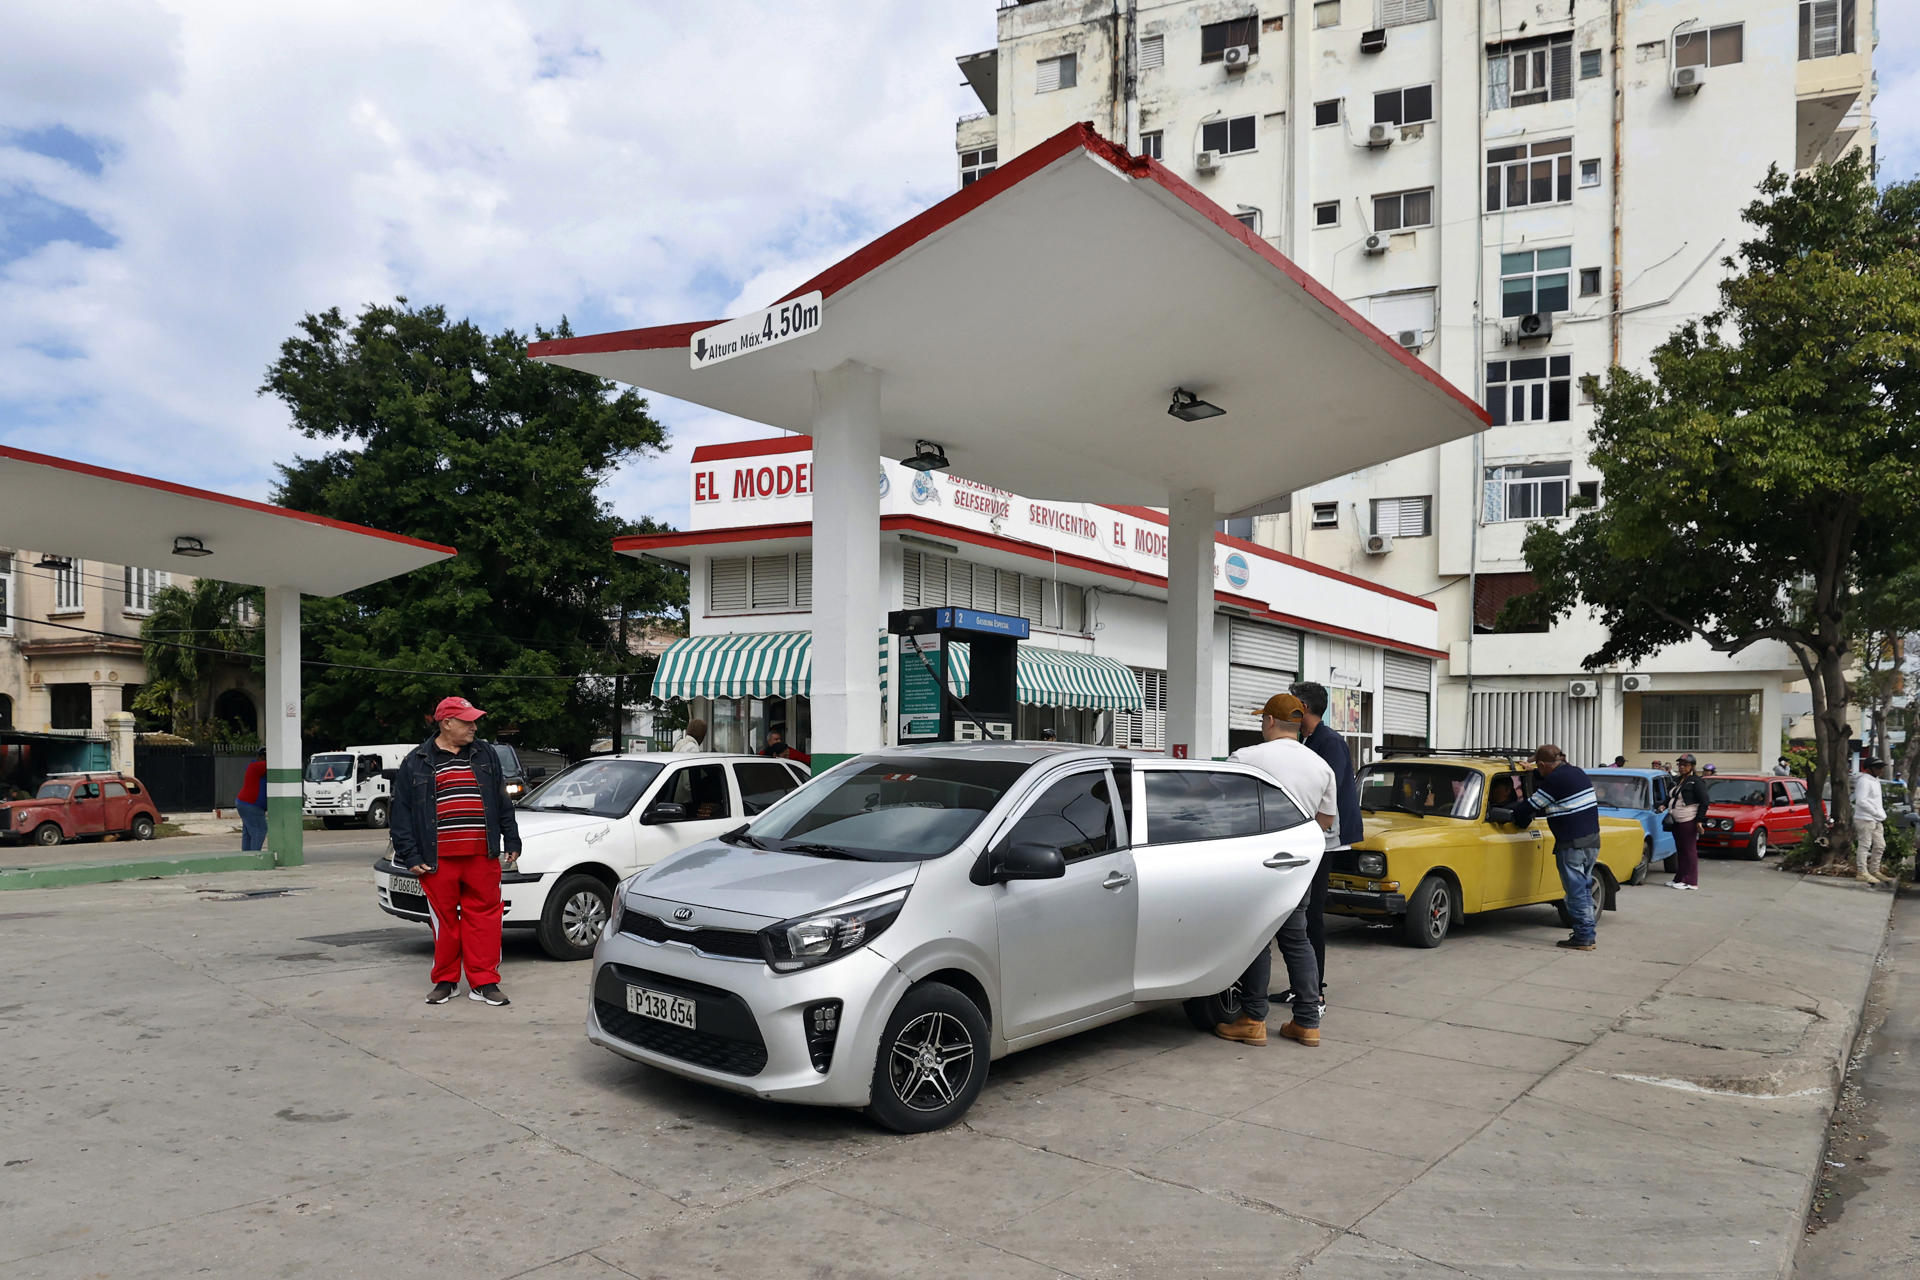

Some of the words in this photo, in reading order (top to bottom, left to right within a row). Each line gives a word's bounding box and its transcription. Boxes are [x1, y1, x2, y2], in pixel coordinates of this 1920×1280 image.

[708, 341, 737, 361] Altura
[740, 332, 763, 351] Máx.
[762, 302, 819, 341] 4.50m
[695, 471, 719, 501] EL
[733, 462, 813, 499] MODE
[954, 489, 1010, 518] SELFSERVICE
[1029, 503, 1097, 539] SERVICENTRO
[1113, 521, 1126, 547] EL
[944, 611, 950, 623] 2
[958, 612, 964, 624] 2
[675, 908, 690, 918] KIA
